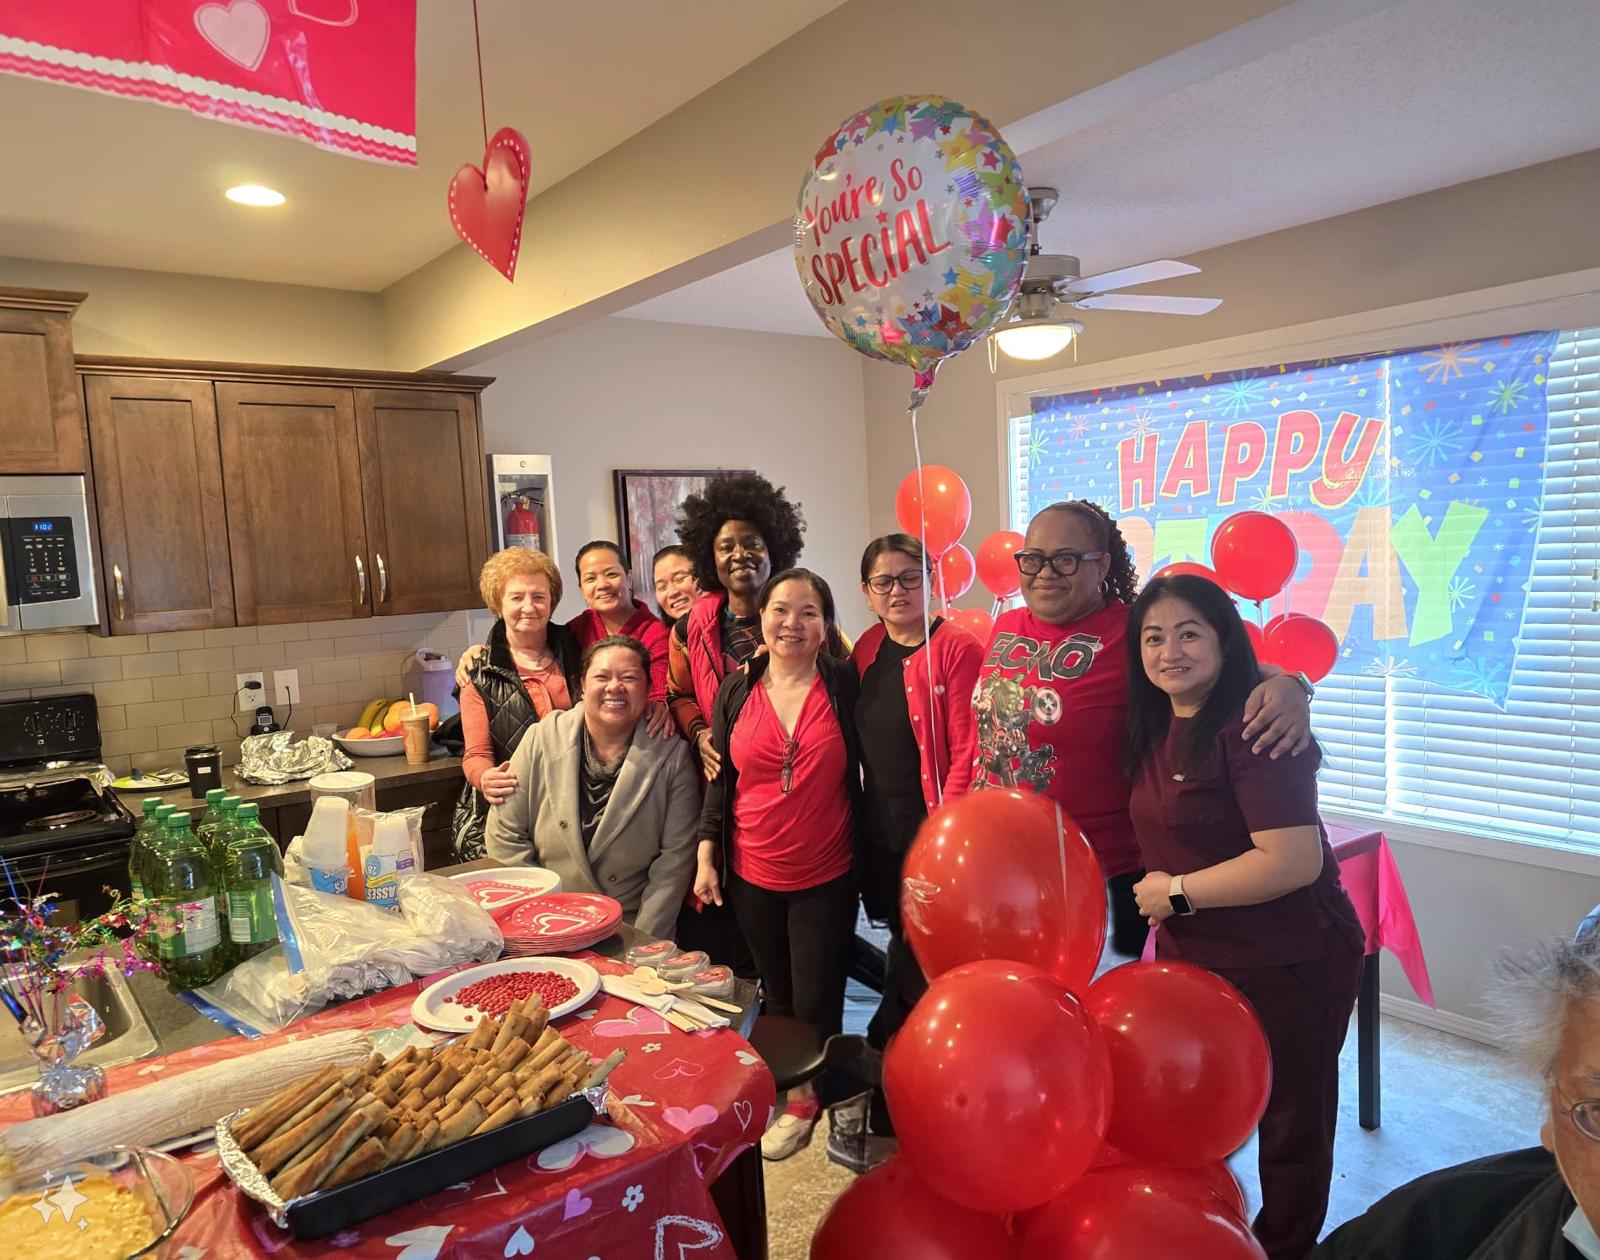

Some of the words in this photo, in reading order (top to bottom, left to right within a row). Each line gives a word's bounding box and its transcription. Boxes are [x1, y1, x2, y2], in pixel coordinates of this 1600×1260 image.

[805, 174, 884, 247] You're
[890, 158, 923, 202] So
[811, 199, 954, 306] SPECIAL
[1118, 409, 1387, 514] HAPPY
